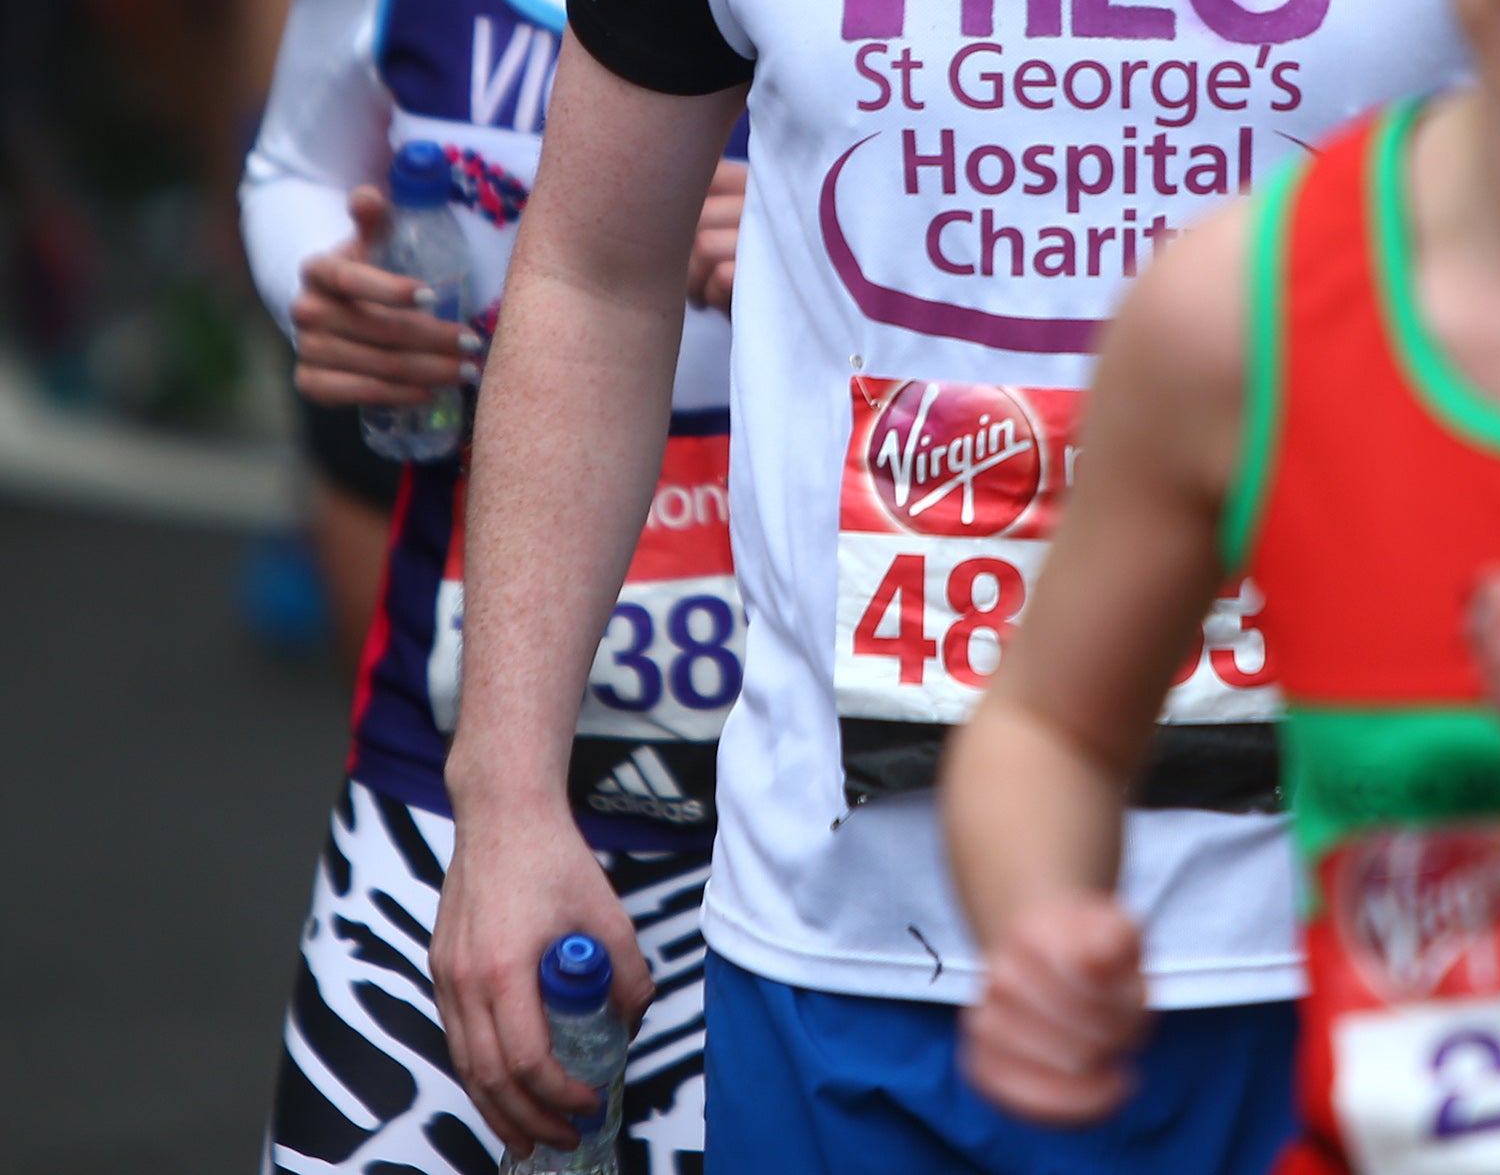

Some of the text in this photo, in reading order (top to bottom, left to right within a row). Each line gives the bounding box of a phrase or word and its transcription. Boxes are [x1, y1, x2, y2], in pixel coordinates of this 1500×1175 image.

[469, 15, 563, 133] VI
[854, 42, 1303, 127] St George's
[901, 126, 1254, 214] Hospital
[924, 208, 1192, 278] Charit
[876, 381, 1033, 526] Virgin
